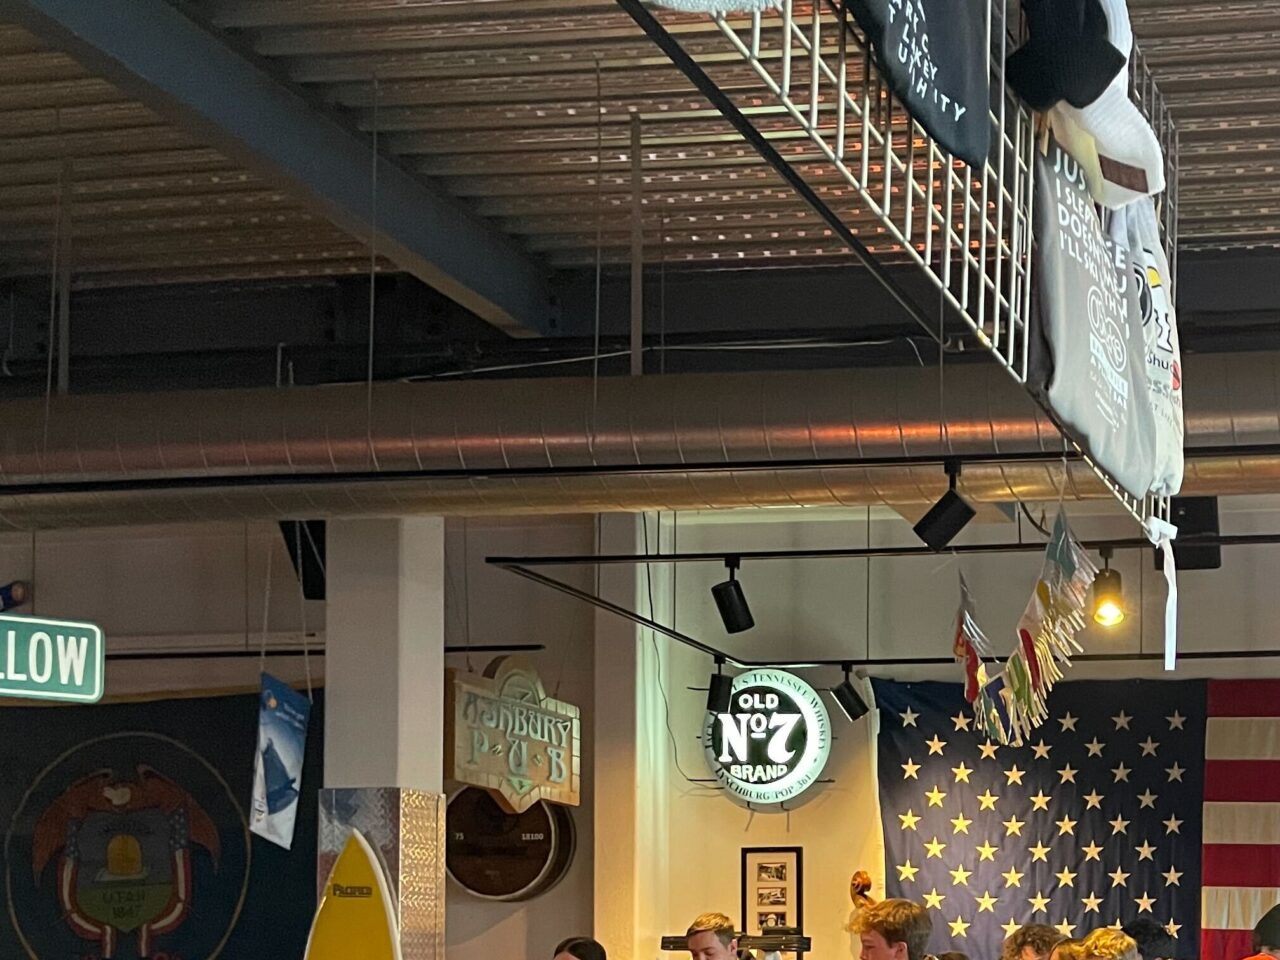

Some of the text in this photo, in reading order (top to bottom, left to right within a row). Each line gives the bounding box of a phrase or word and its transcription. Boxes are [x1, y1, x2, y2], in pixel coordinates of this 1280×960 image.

[1054, 147, 1086, 191] JUS
[462, 691, 571, 748] ASHBURY
[738, 693, 779, 709] OLD
[808, 697, 826, 750] WHISKEY
[714, 766, 770, 800] LYNCHBURG
[775, 785, 794, 799] POP
[730, 764, 788, 783] BRAND
